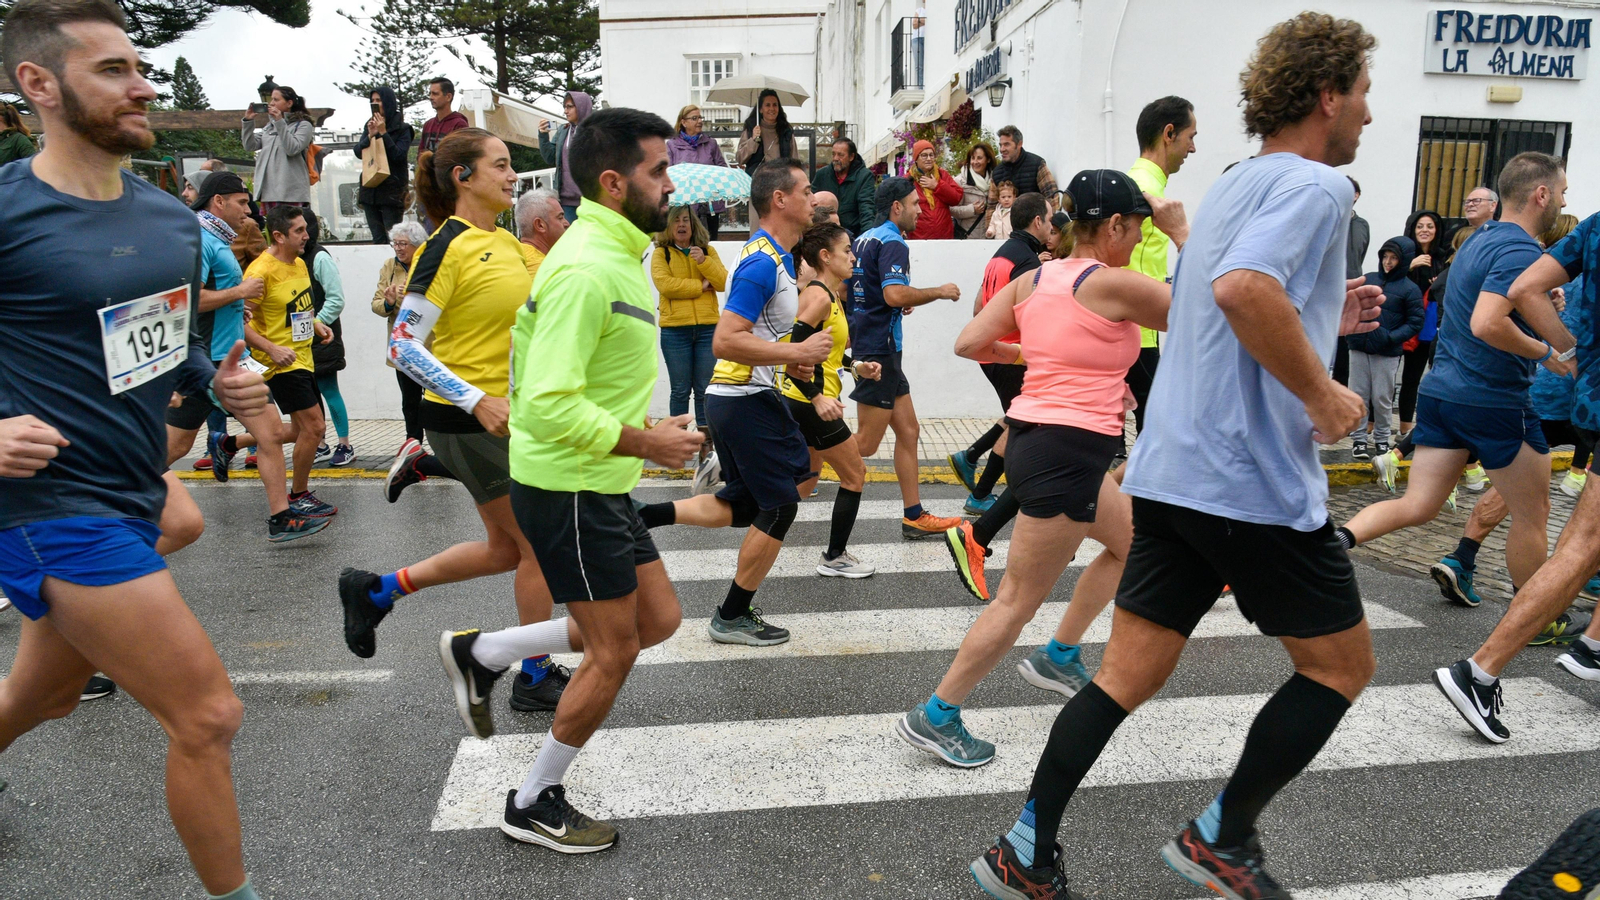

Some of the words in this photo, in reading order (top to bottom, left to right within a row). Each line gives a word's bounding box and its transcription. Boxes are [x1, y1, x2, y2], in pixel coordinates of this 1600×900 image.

[1434, 10, 1592, 48] FREIDURIA
[1443, 48, 1469, 73] LA
[1487, 46, 1575, 78] ALMENA
[127, 320, 169, 363] 192
